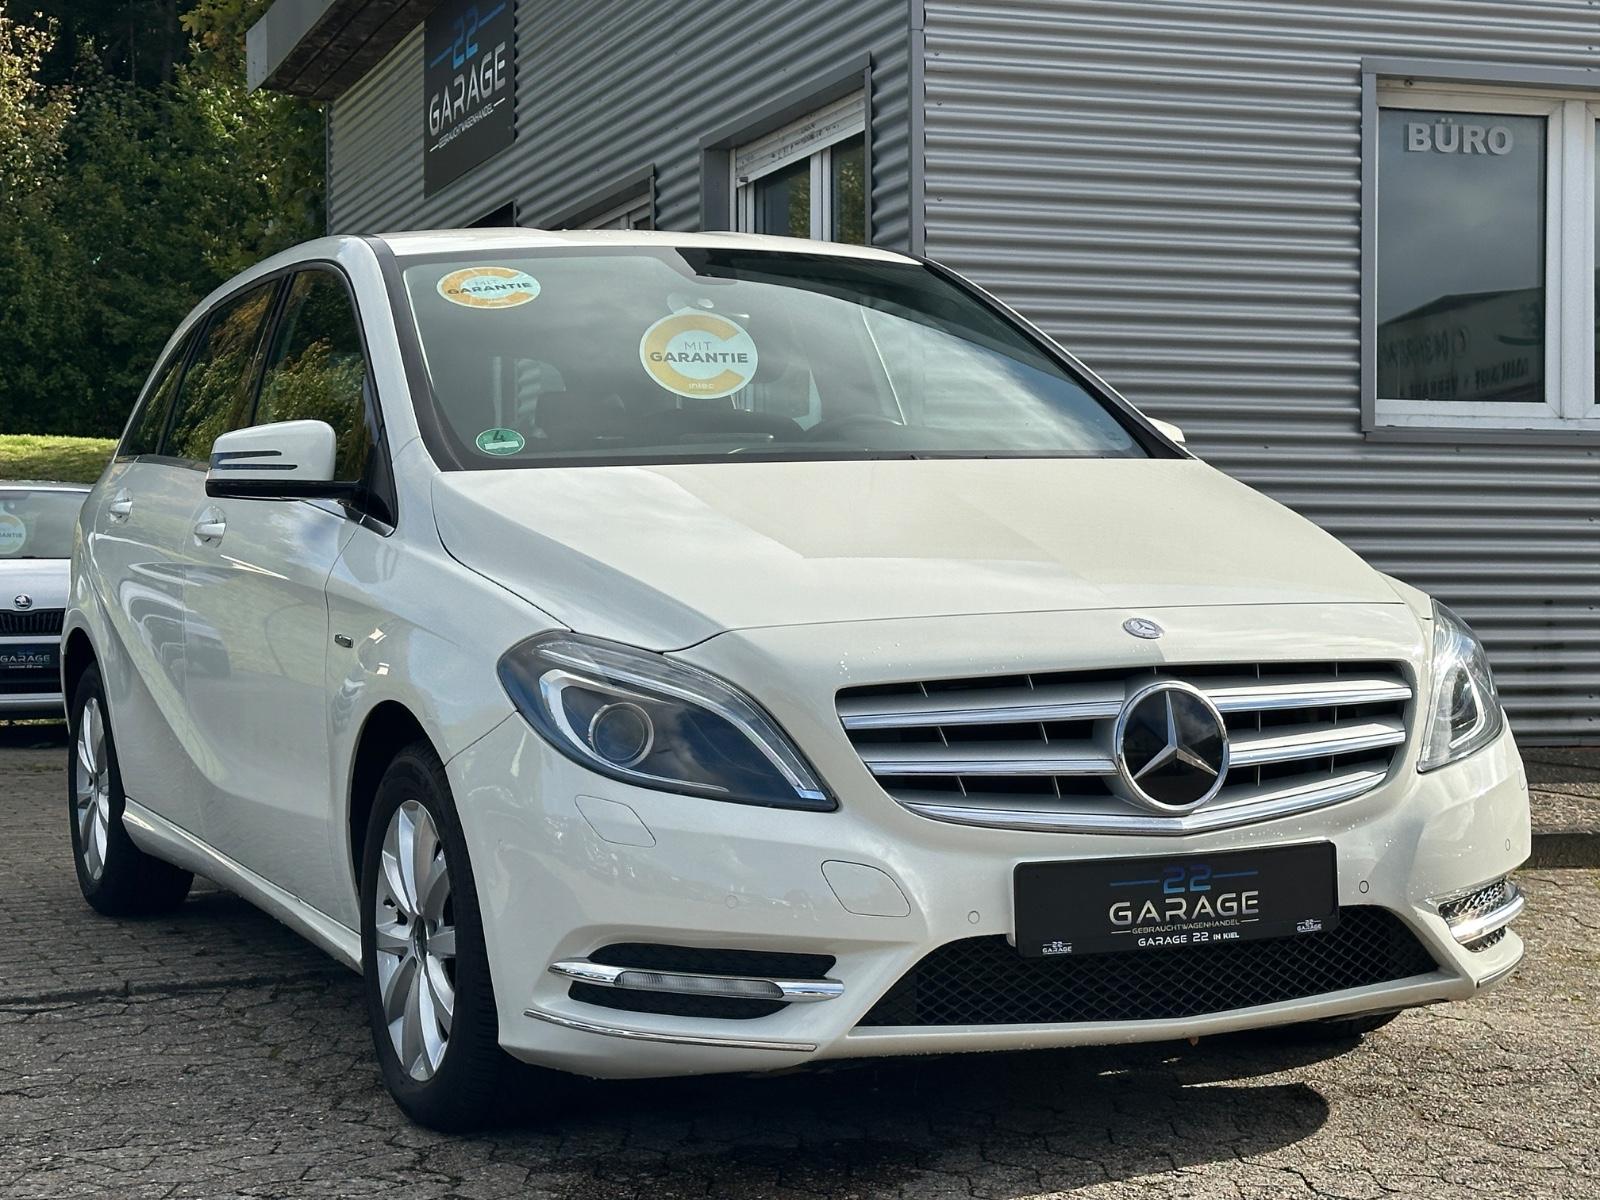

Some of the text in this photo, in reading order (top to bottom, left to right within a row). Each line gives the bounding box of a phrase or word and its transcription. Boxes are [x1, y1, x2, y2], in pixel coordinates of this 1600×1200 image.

[452, 6, 479, 70] 22
[429, 41, 506, 137] GARAGE
[1408, 117, 1515, 155] BÜRO
[447, 282, 533, 295] GARANTIE
[684, 341, 712, 351] MIT
[650, 352, 749, 363] GARANTIE
[0, 654, 51, 663] GARAGE
[1163, 864, 1212, 894] 22
[1109, 890, 1259, 926] GARAGE
[1132, 919, 1240, 935] GEBRAUCHTWAGENHANDEL
[1137, 931, 1240, 947] GARAGE 22 IN KIEL
